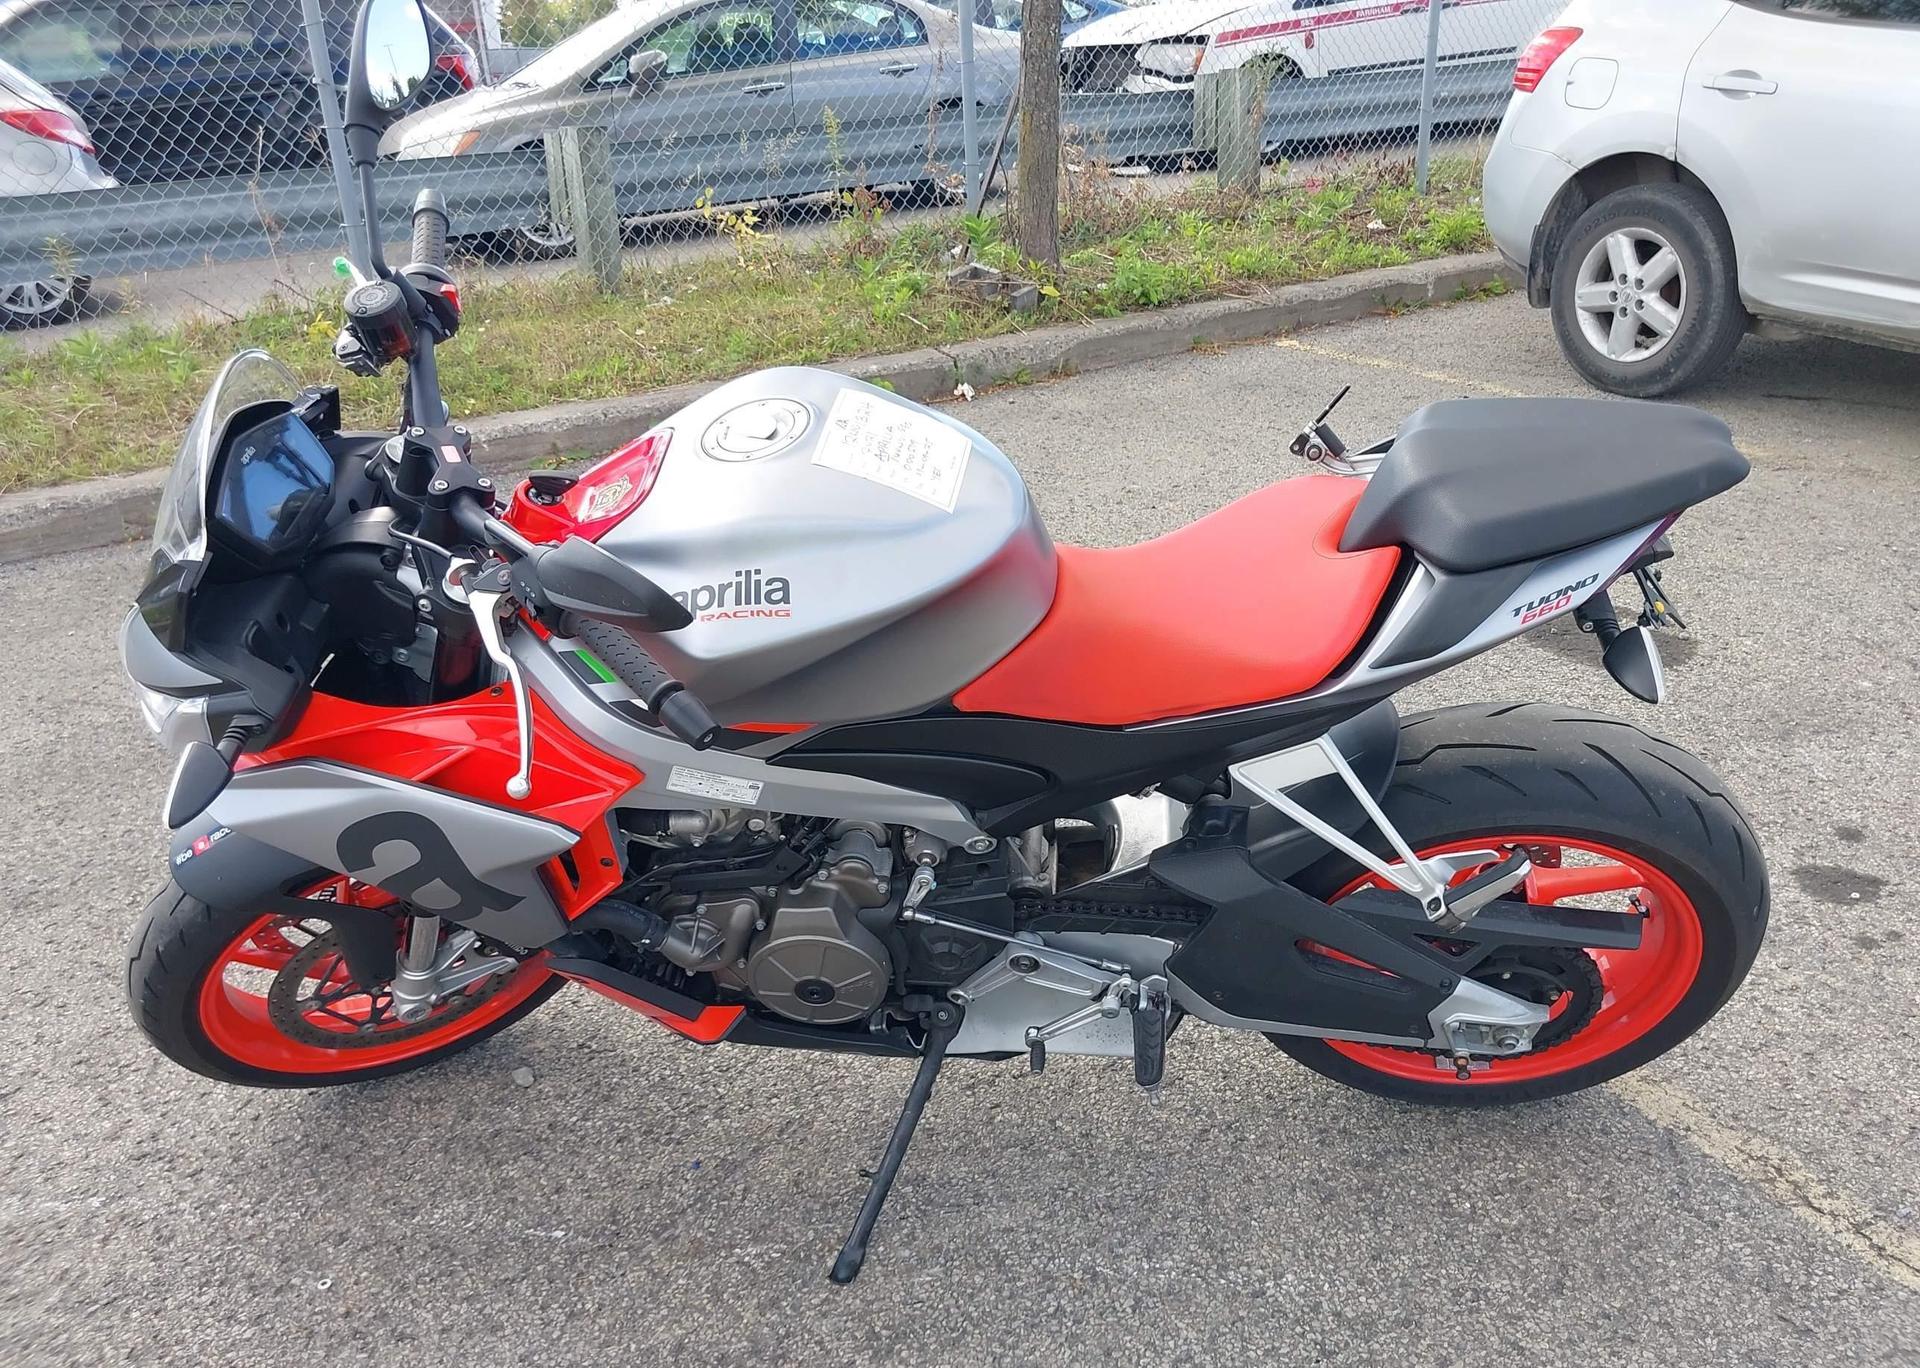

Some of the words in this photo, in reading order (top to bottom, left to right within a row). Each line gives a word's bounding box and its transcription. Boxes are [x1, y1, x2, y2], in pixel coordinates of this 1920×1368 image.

[1512, 573, 1600, 617] TUONO
[1520, 594, 1572, 625] 660
[701, 609, 791, 622] RACING
